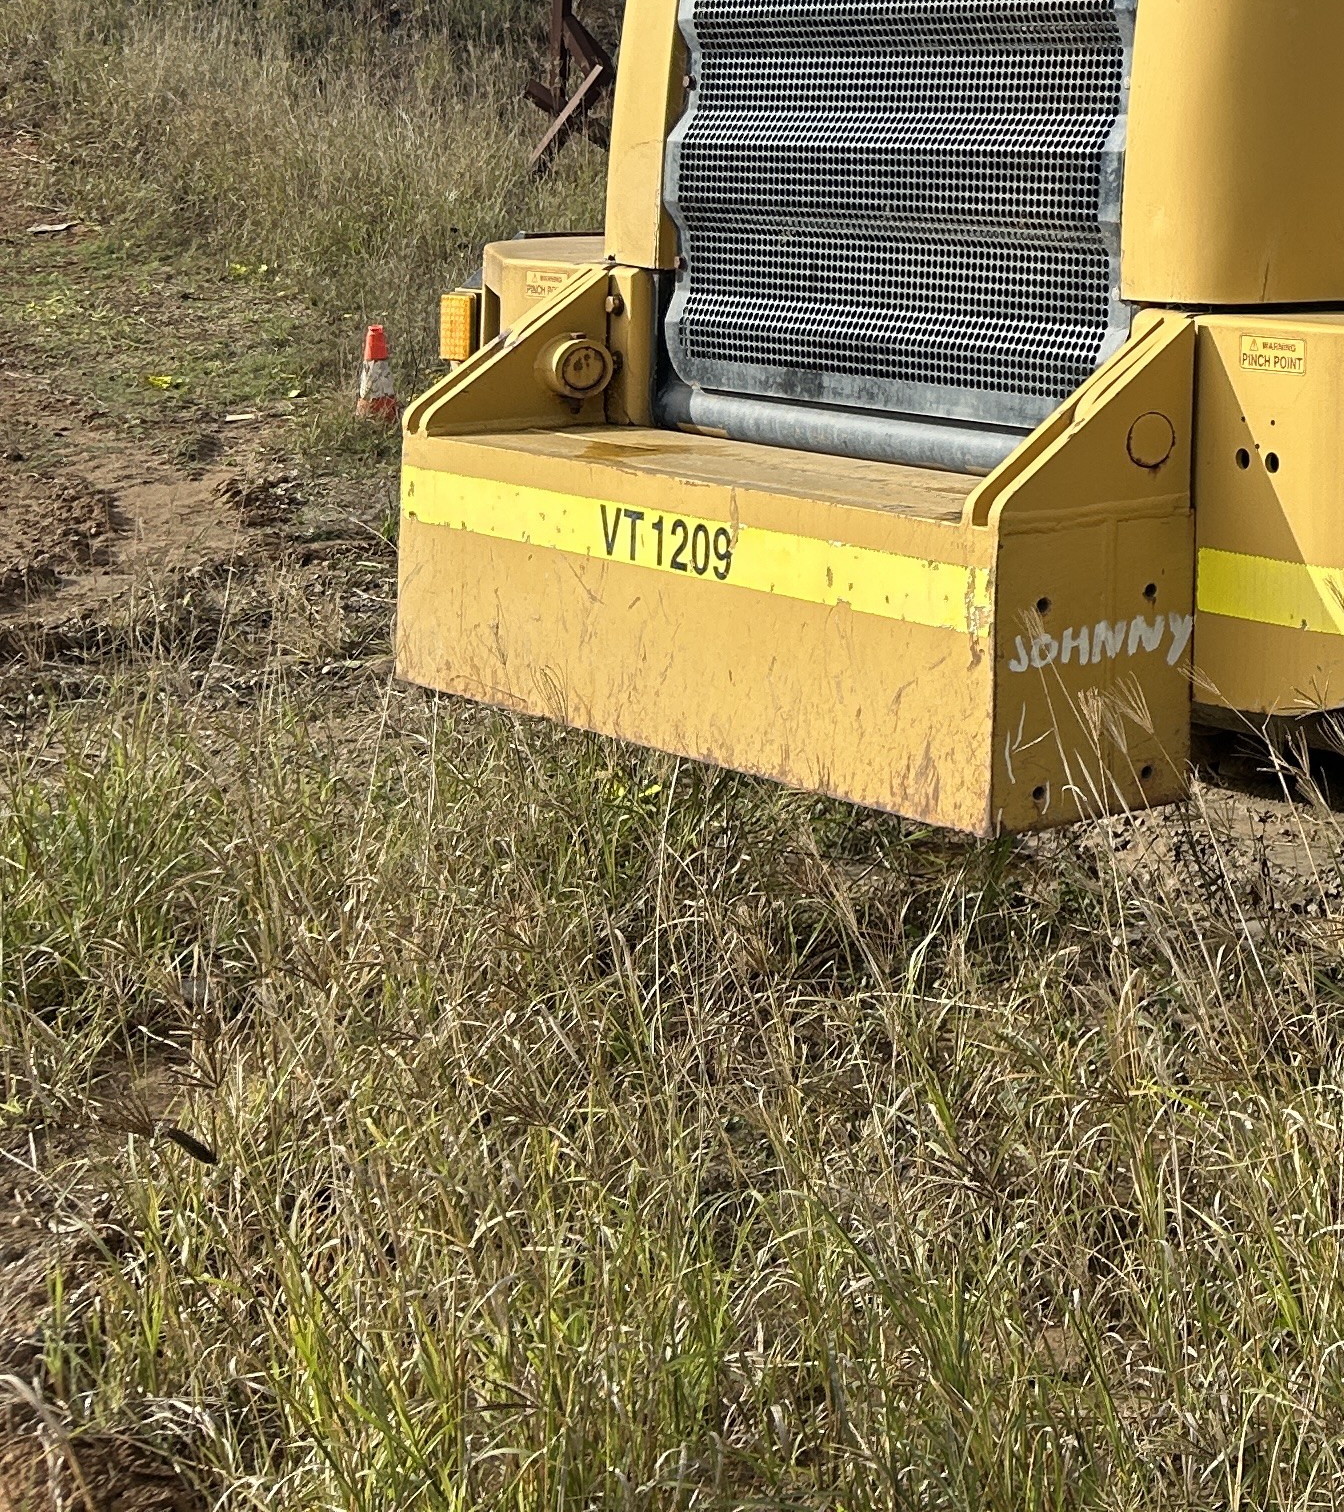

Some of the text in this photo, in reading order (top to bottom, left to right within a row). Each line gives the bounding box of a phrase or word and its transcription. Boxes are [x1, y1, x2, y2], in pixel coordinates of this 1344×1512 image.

[1262, 341, 1297, 353] WARNING
[1242, 353, 1304, 370] PINCH POINT
[1007, 610, 1194, 674] JOHNNY
